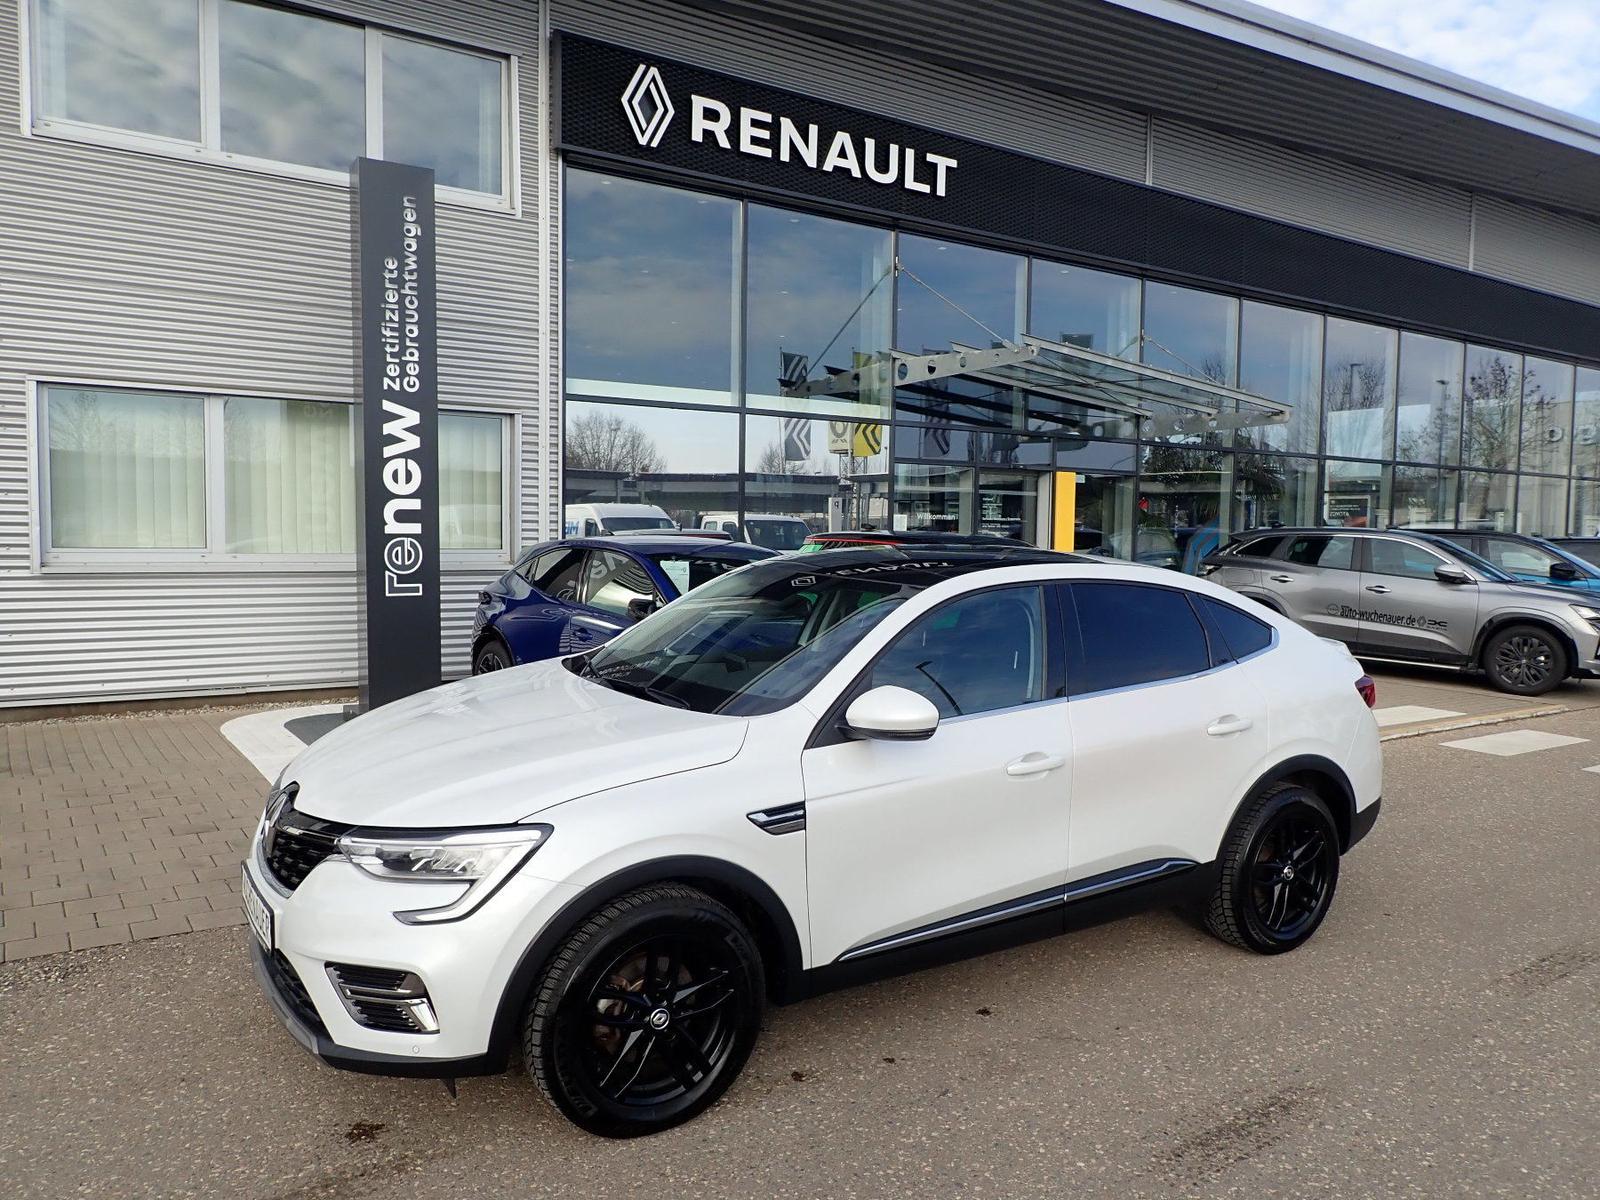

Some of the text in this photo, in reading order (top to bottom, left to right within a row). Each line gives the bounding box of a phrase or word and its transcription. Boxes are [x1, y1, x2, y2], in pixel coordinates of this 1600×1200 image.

[691, 94, 958, 196] RENAULT
[382, 256, 400, 391] Zertifizierte
[401, 195, 422, 393] Gebrauchtwagen
[382, 399, 423, 597] renew
[916, 512, 956, 521] Willkommen
[1340, 606, 1417, 627] auto-wuchenauer.de
